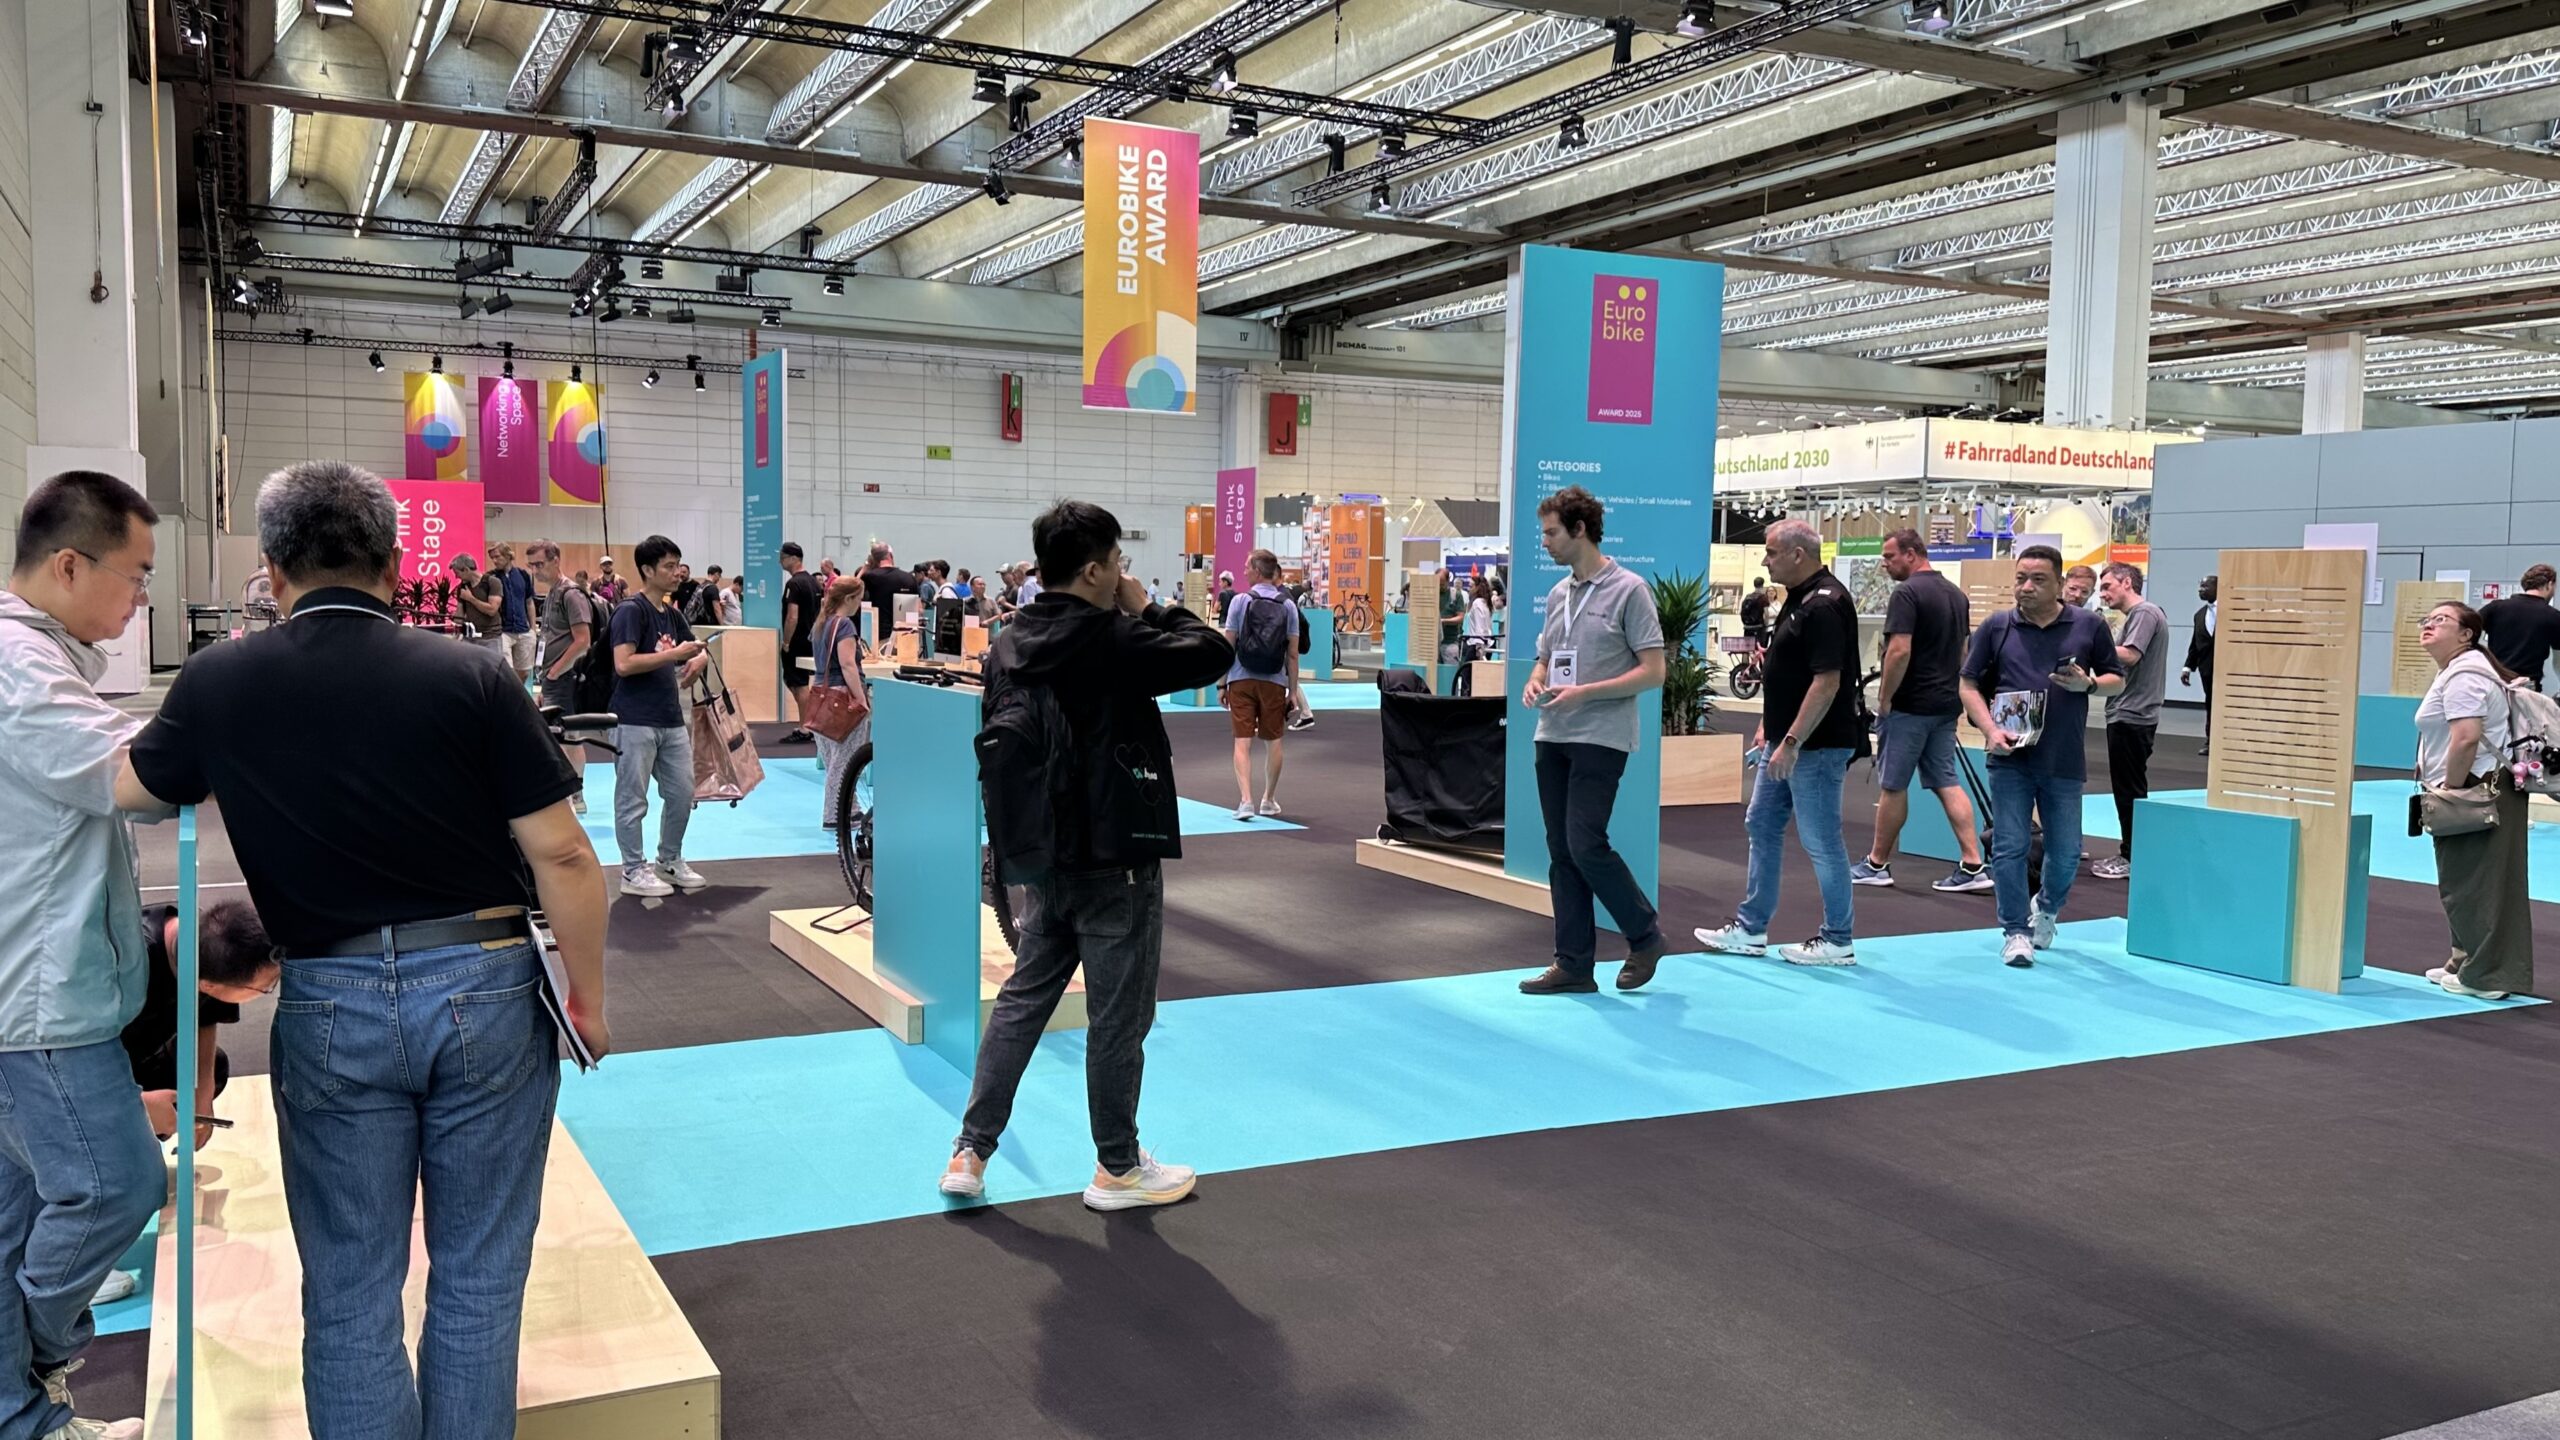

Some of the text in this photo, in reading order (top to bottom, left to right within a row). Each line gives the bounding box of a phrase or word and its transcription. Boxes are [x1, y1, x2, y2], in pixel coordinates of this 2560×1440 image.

[1117, 145, 1140, 295] EUROBIKE
[1145, 149, 1168, 266] AWARD
[1603, 299, 1646, 322] Euro
[1602, 320, 1645, 342] bike
[1336, 341, 1367, 350] DEMAG
[496, 379, 511, 458] Networking
[510, 385, 524, 425] Space
[1006, 403, 1018, 431] K
[1598, 407, 1643, 418] AWARD 2025
[1276, 420, 1291, 446] J
[1538, 460, 1601, 473] CATEGORIES
[1714, 448, 1830, 475] utschland 2030
[1225, 483, 1235, 526] Pink
[1234, 483, 1245, 544] Stage
[1608, 496, 1635, 504] Vehicles
[1639, 497, 1656, 505] Small
[417, 499, 446, 577] Stage
